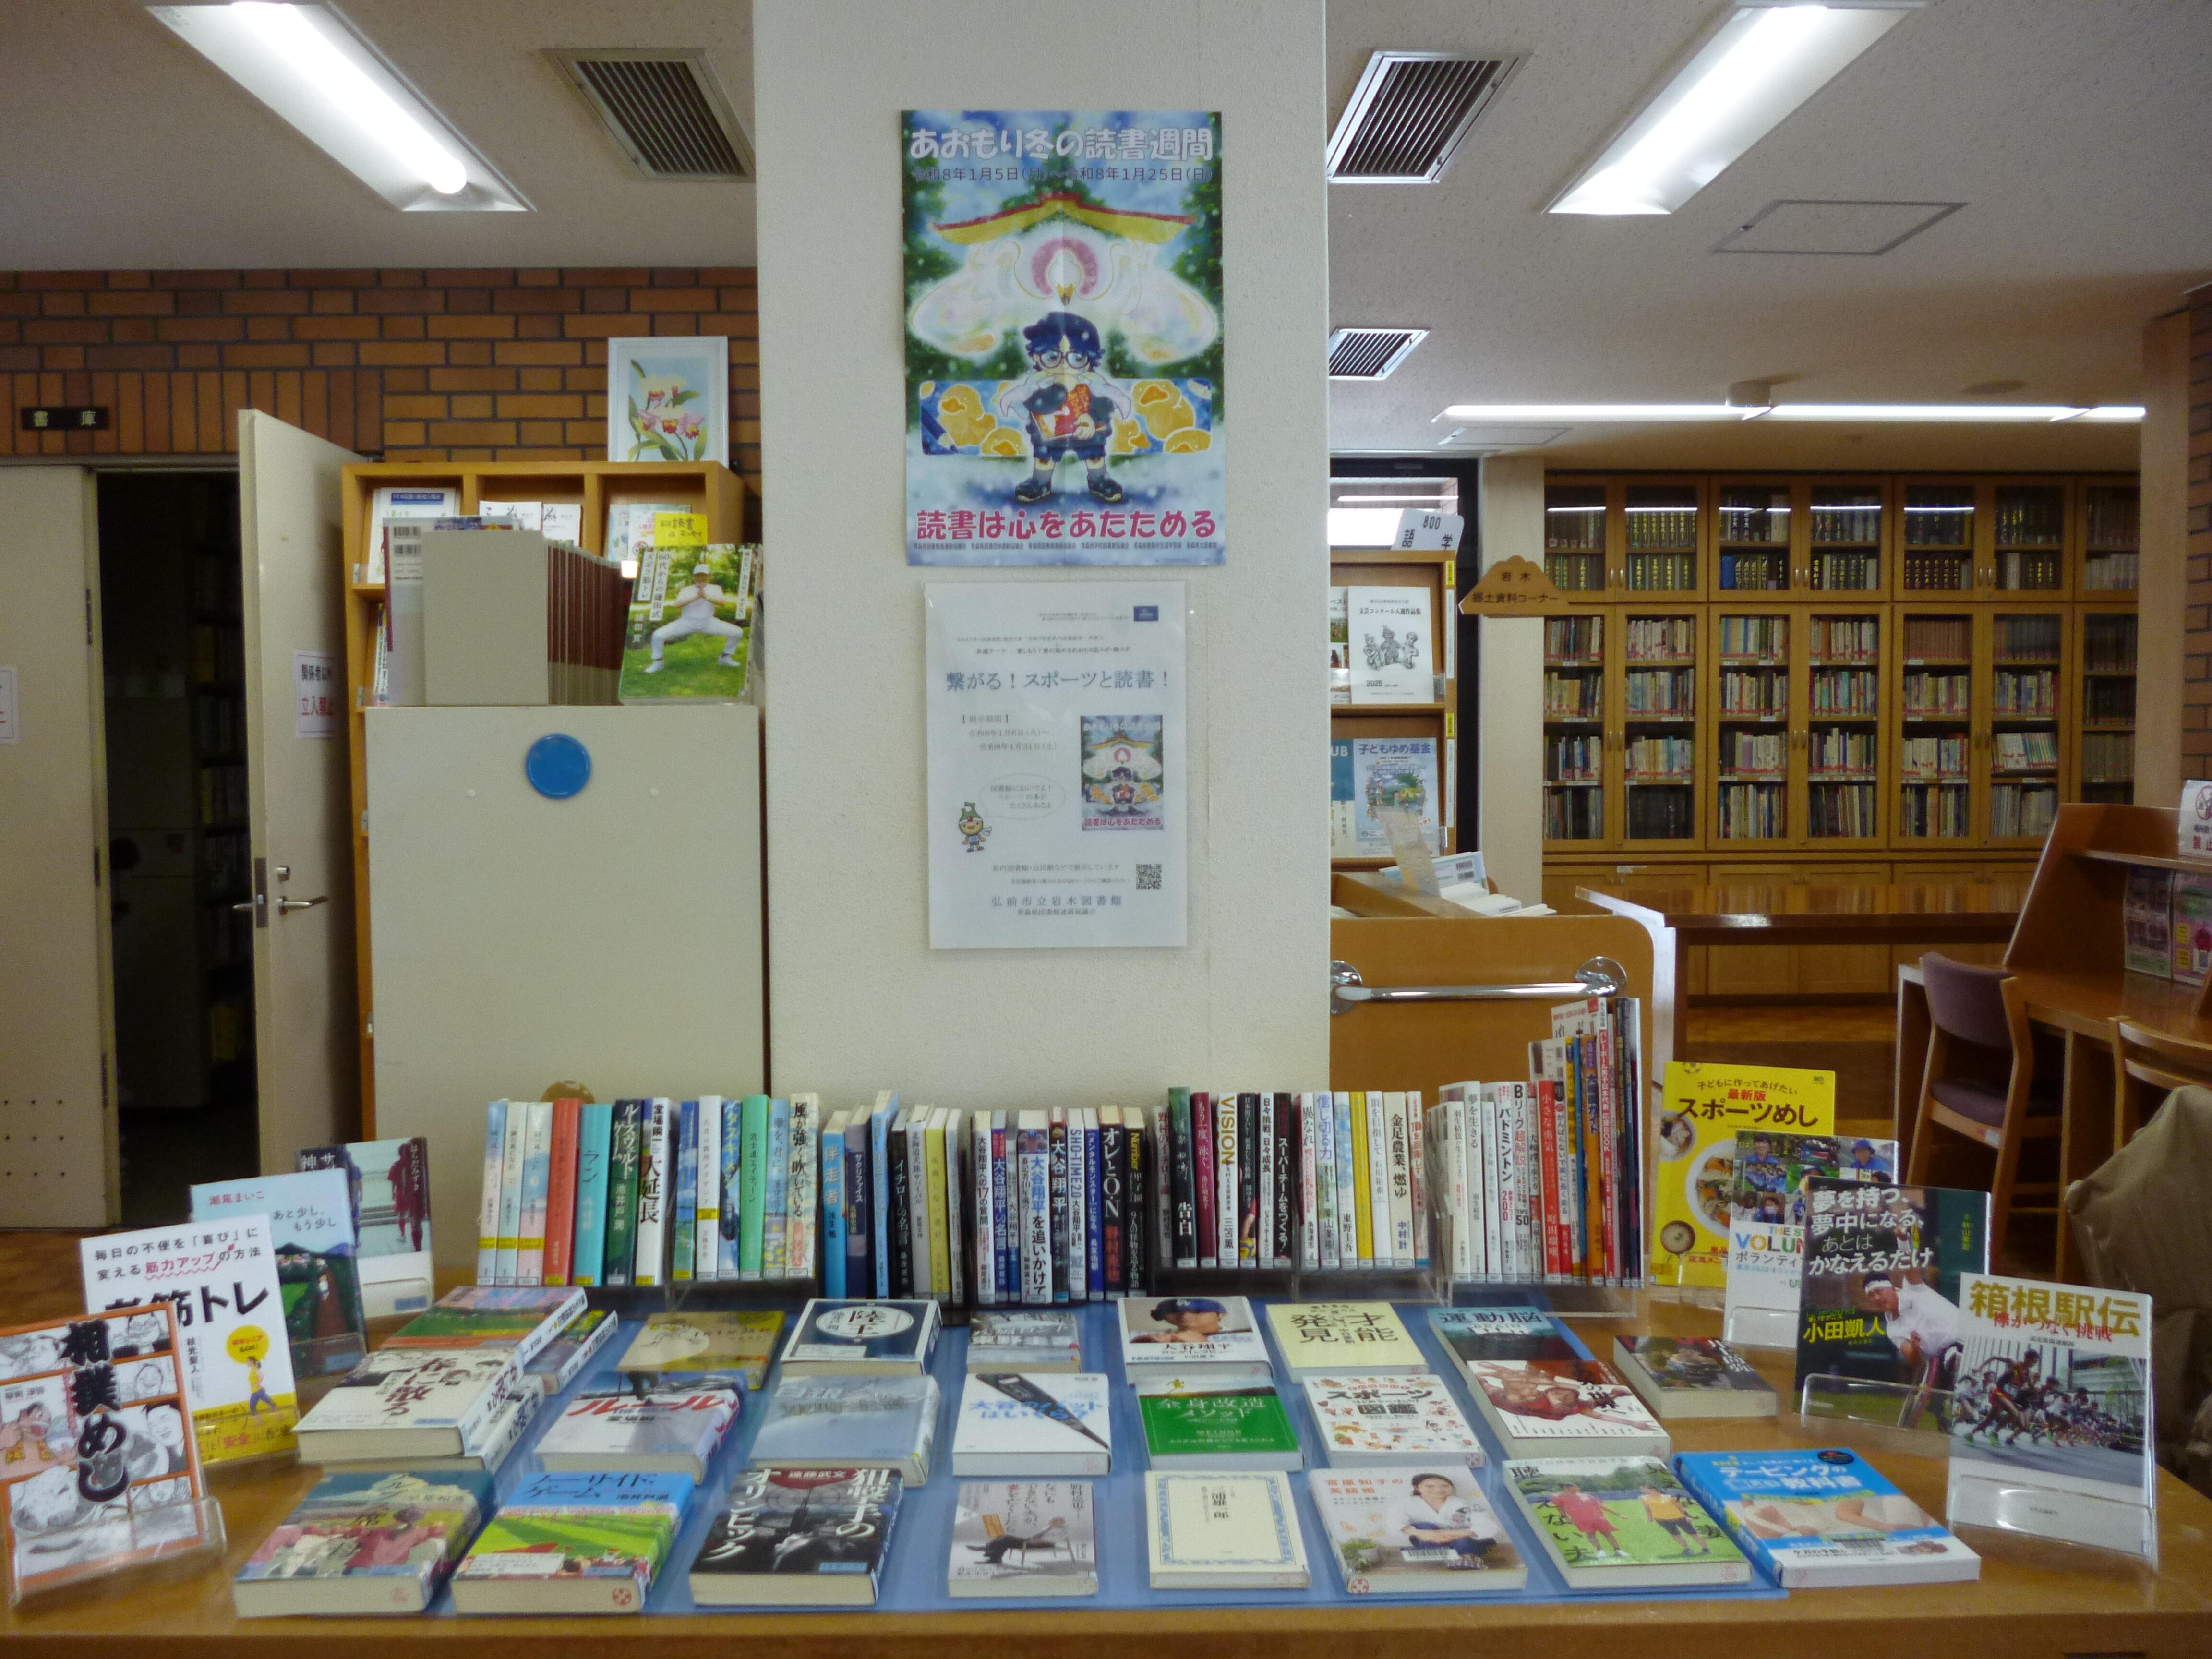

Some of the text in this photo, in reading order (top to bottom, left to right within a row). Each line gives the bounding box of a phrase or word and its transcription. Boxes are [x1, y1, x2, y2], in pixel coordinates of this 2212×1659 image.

[911, 128, 1214, 160] あおもり冬の読書週間
[916, 509, 1216, 540] 読書は心をあたためる
[1423, 515, 1441, 530] 800
[1502, 571, 1531, 582] 岩木
[1472, 592, 1559, 604] 郷土資料コーナー
[946, 670, 1169, 692] 繋がる！スポーツと読書！
[1358, 743, 1431, 755] 子どもゆめ基金
[991, 895, 1122, 907] 弘前市立岩木図書館
[1697, 1078, 1798, 1095] 子どもに作ってあげたい
[1728, 1089, 1766, 1102] 最新版
[1302, 1106, 1314, 1146] 異なれ
[1468, 1094, 1479, 1148] 夢を生きる
[1677, 1097, 1818, 1127] スポーツめし
[1221, 1095, 1236, 1166] VISION
[1262, 1098, 1271, 1174] 日々挑戦、日々成長
[1317, 1094, 1332, 1161] 信じ切る力
[791, 1101, 808, 1217] 風が強く吹いている
[1391, 1114, 1407, 1199] 金足農業、燃ゆ
[1499, 1108, 1512, 1182] バドミントン
[640, 1155, 661, 1224] 大延長
[824, 1145, 840, 1206] 伴走者
[854, 1153, 864, 1203] サクリファイス
[977, 1136, 989, 1226] 大谷翔平への17の質問
[1051, 1140, 1067, 1214] 大谷翔平
[209, 1190, 265, 1205] 瀬尾まいこ
[993, 1158, 1006, 1250] 大谷翔平の名言
[1812, 1186, 1909, 1213] 夢を持つ、
[293, 1218, 337, 1231] もう少し
[1071, 1200, 1083, 1231] 大谷翔平
[1811, 1209, 1924, 1235] 夢中になる、
[95, 1226, 259, 1261] 毎日の不便を「喜び」に
[1822, 1232, 1873, 1253] あとは
[97, 1246, 263, 1281] 変える筋力アップの方法
[1808, 1247, 1934, 1276] かなえるだけ
[1439, 1311, 1542, 1323] 運動脳
[1969, 1279, 2141, 1338] 箱根駅伝
[1291, 1314, 1339, 1343] 発見
[1802, 1316, 1885, 1344] 小田凱人
[1327, 1389, 1433, 1399] スポーツ
[1357, 1404, 1419, 1414] 図鑑
